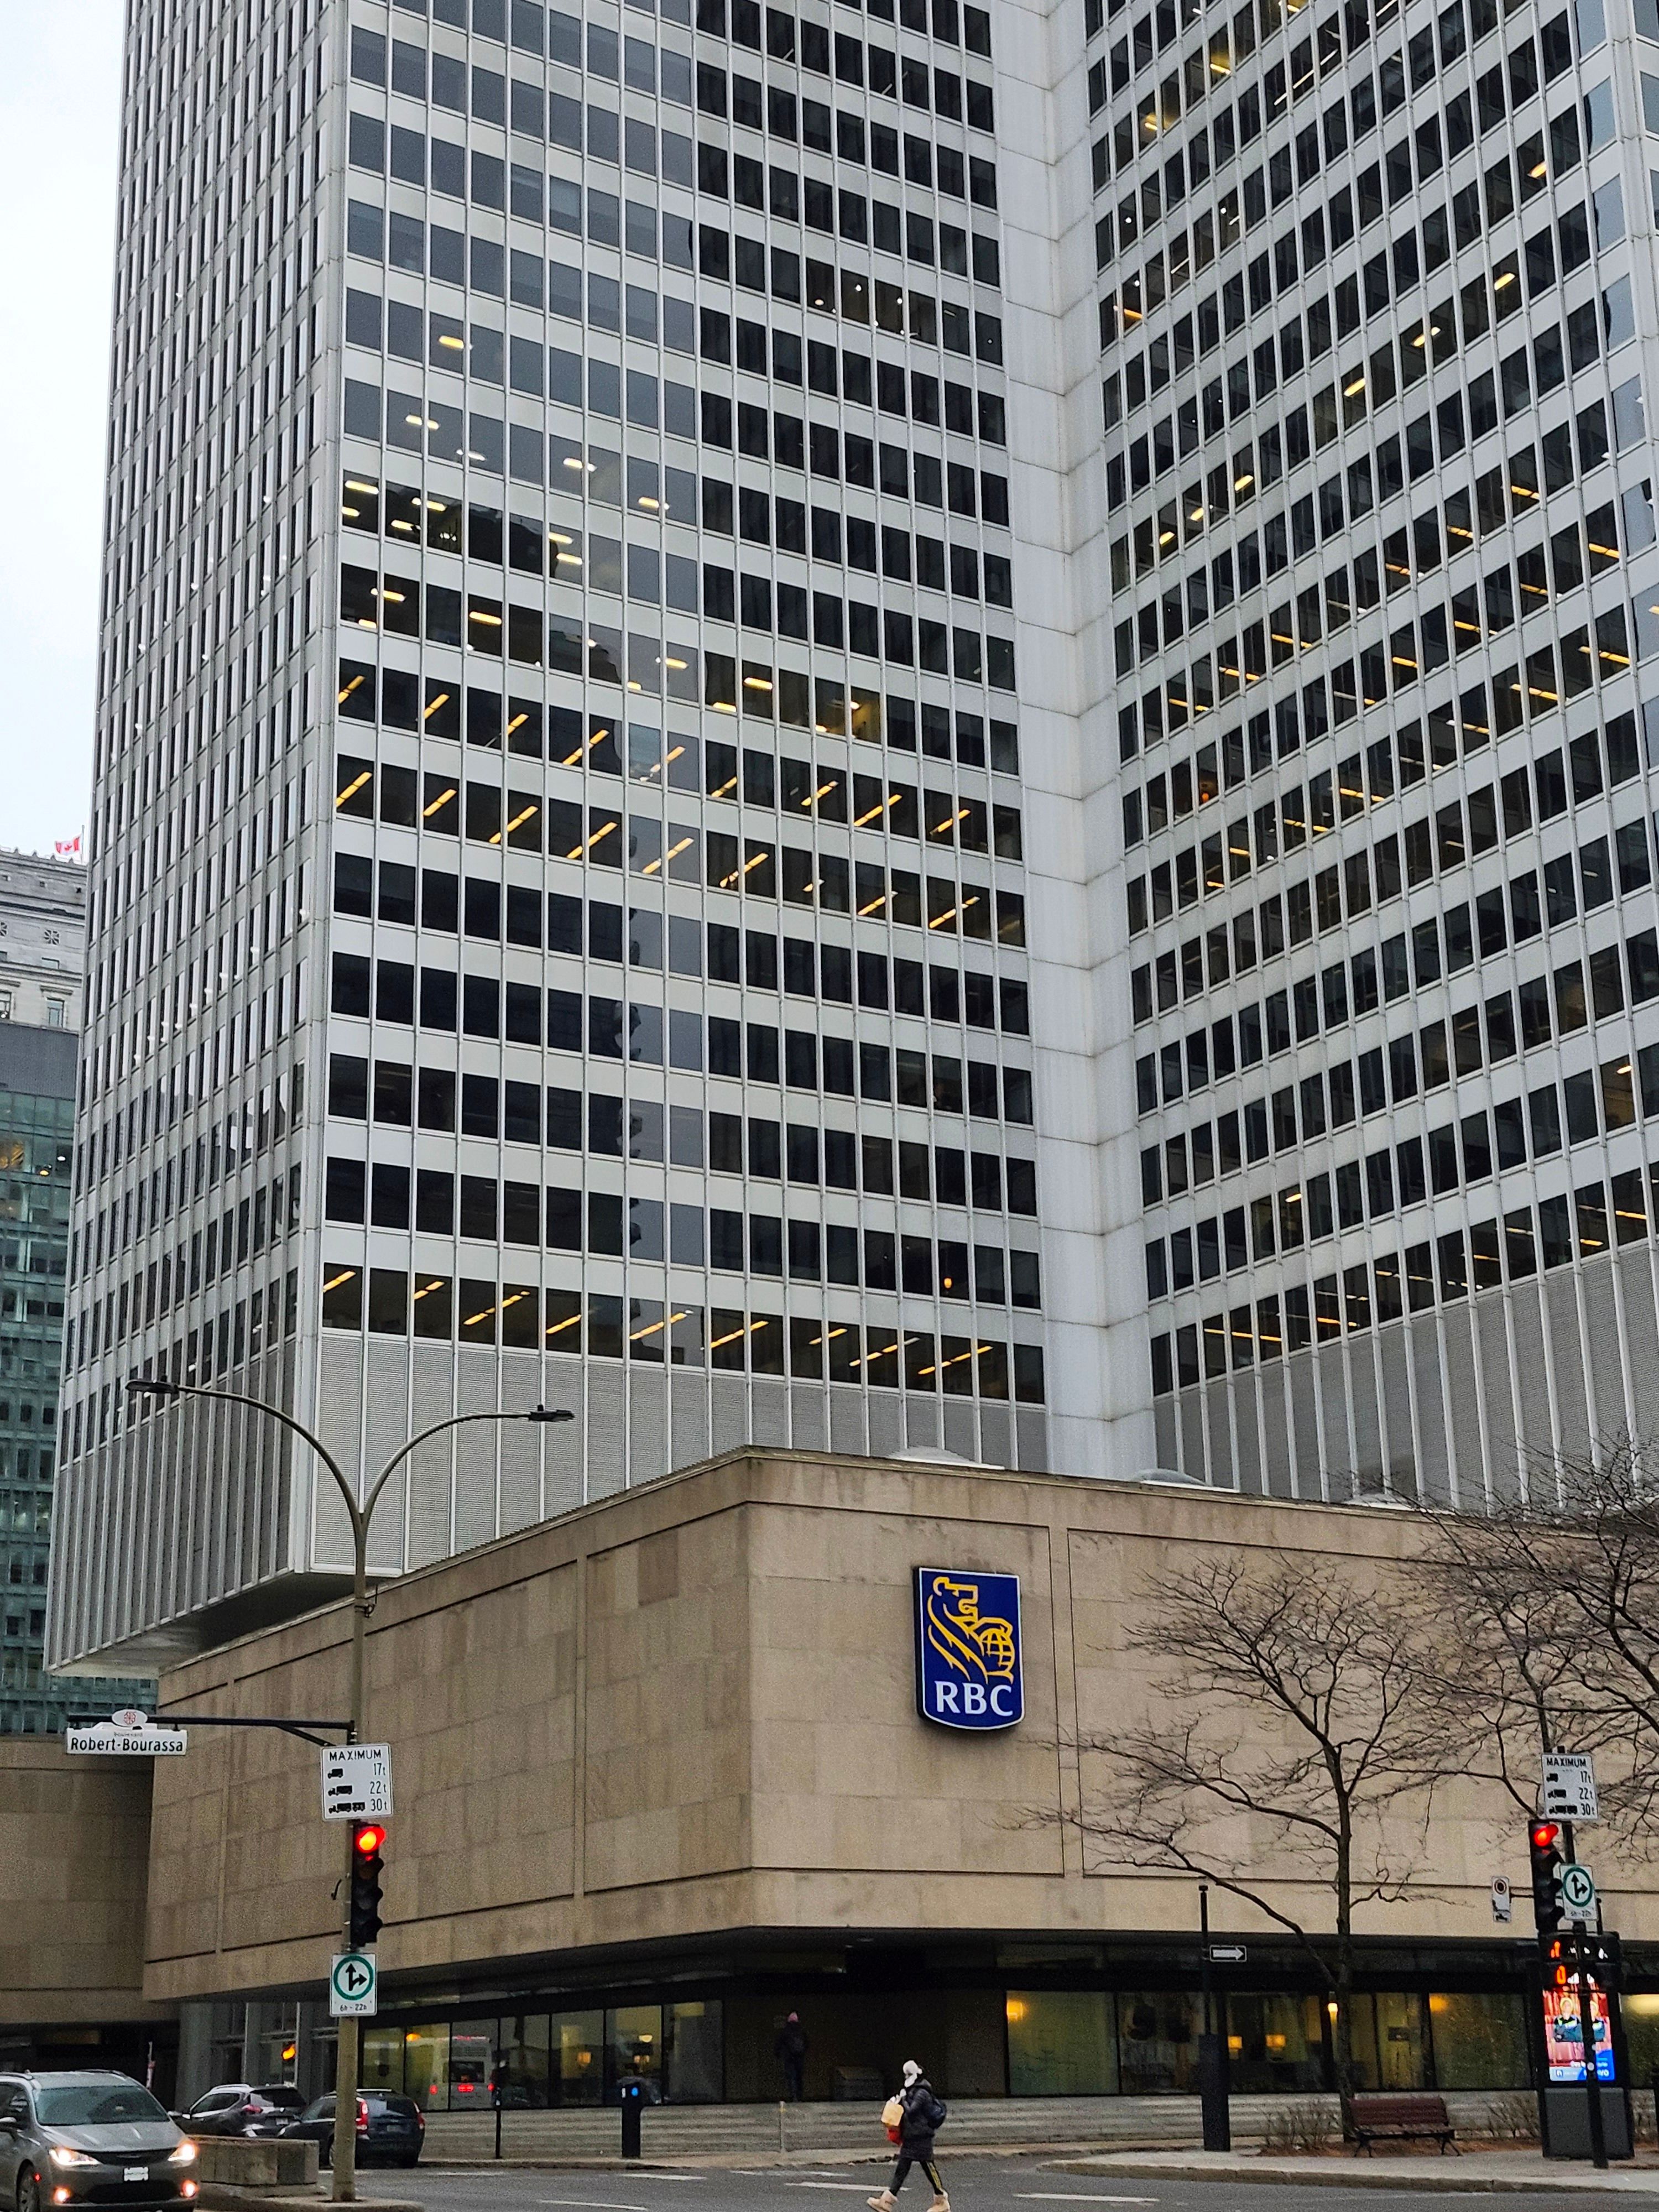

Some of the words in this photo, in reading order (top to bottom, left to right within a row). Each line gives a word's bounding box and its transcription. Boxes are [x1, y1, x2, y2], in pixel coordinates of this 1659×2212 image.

[935, 1680, 1013, 1717] RBC
[71, 1737, 182, 1752] Robert-Bourassa
[329, 1749, 382, 1761] MAXIMUM
[1546, 1757, 1587, 1767] MAXIMUM
